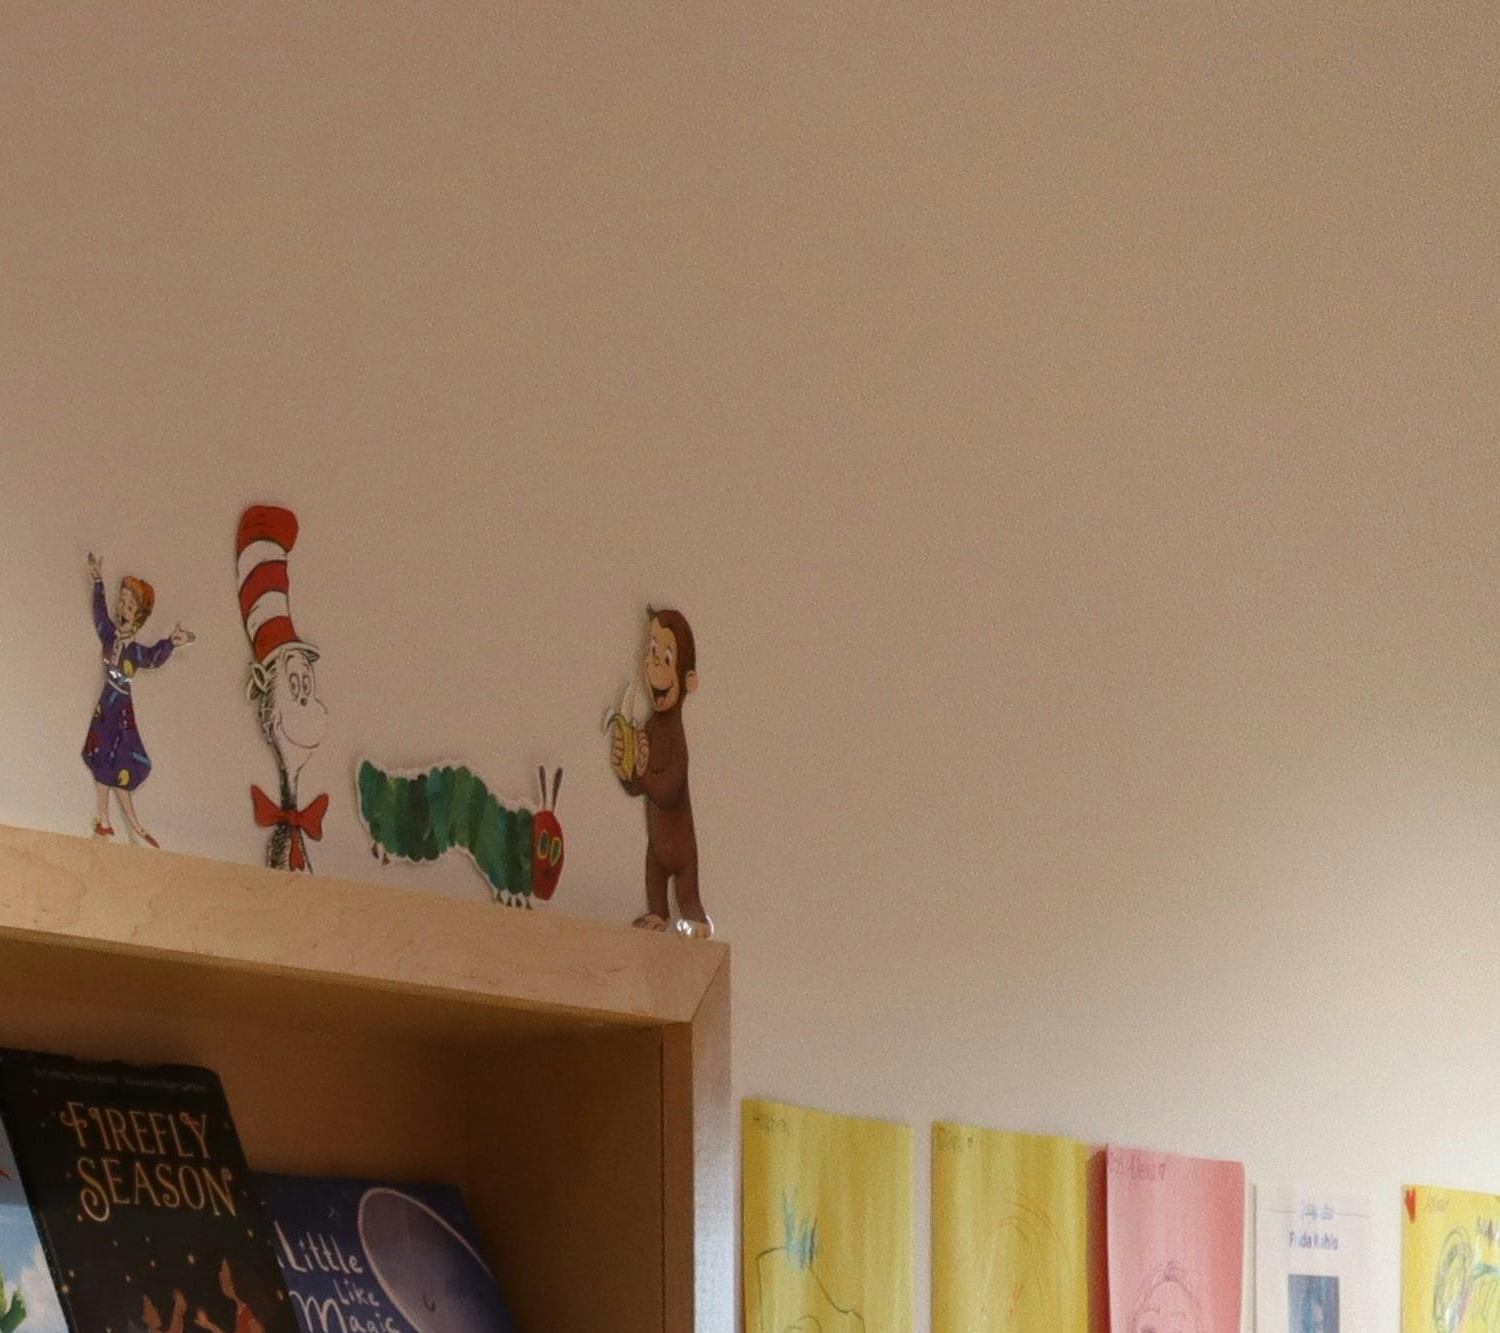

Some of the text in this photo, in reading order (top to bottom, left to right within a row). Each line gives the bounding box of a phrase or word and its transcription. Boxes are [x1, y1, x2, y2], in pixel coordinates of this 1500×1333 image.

[60, 1100, 210, 1161] FIREFLY
[75, 1156, 238, 1223] SEASON
[274, 1221, 364, 1276] Little
[337, 1280, 380, 1309] like
